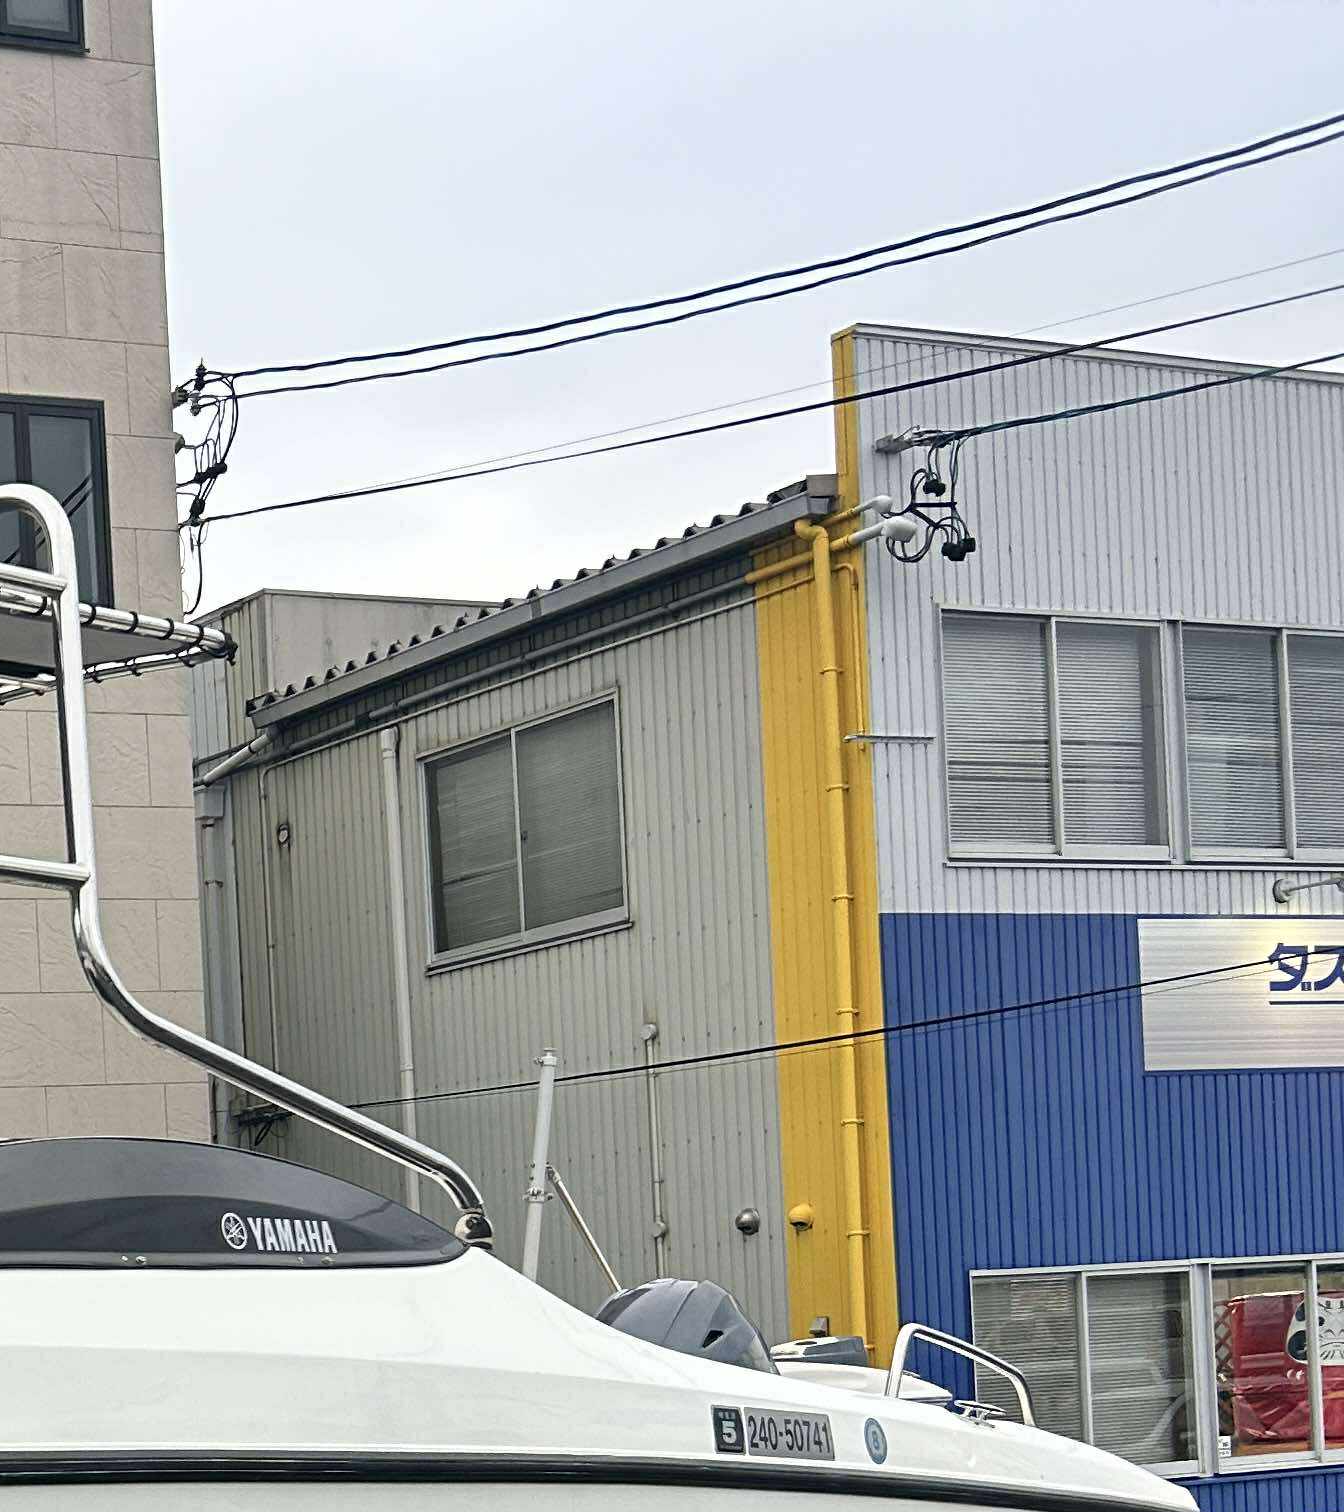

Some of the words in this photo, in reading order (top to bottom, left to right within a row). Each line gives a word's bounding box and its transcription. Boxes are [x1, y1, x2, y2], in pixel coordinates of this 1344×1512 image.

[246, 1217, 338, 1254] YAMAHA
[722, 1420, 737, 1444] 5
[748, 1415, 831, 1453] 240-50741
